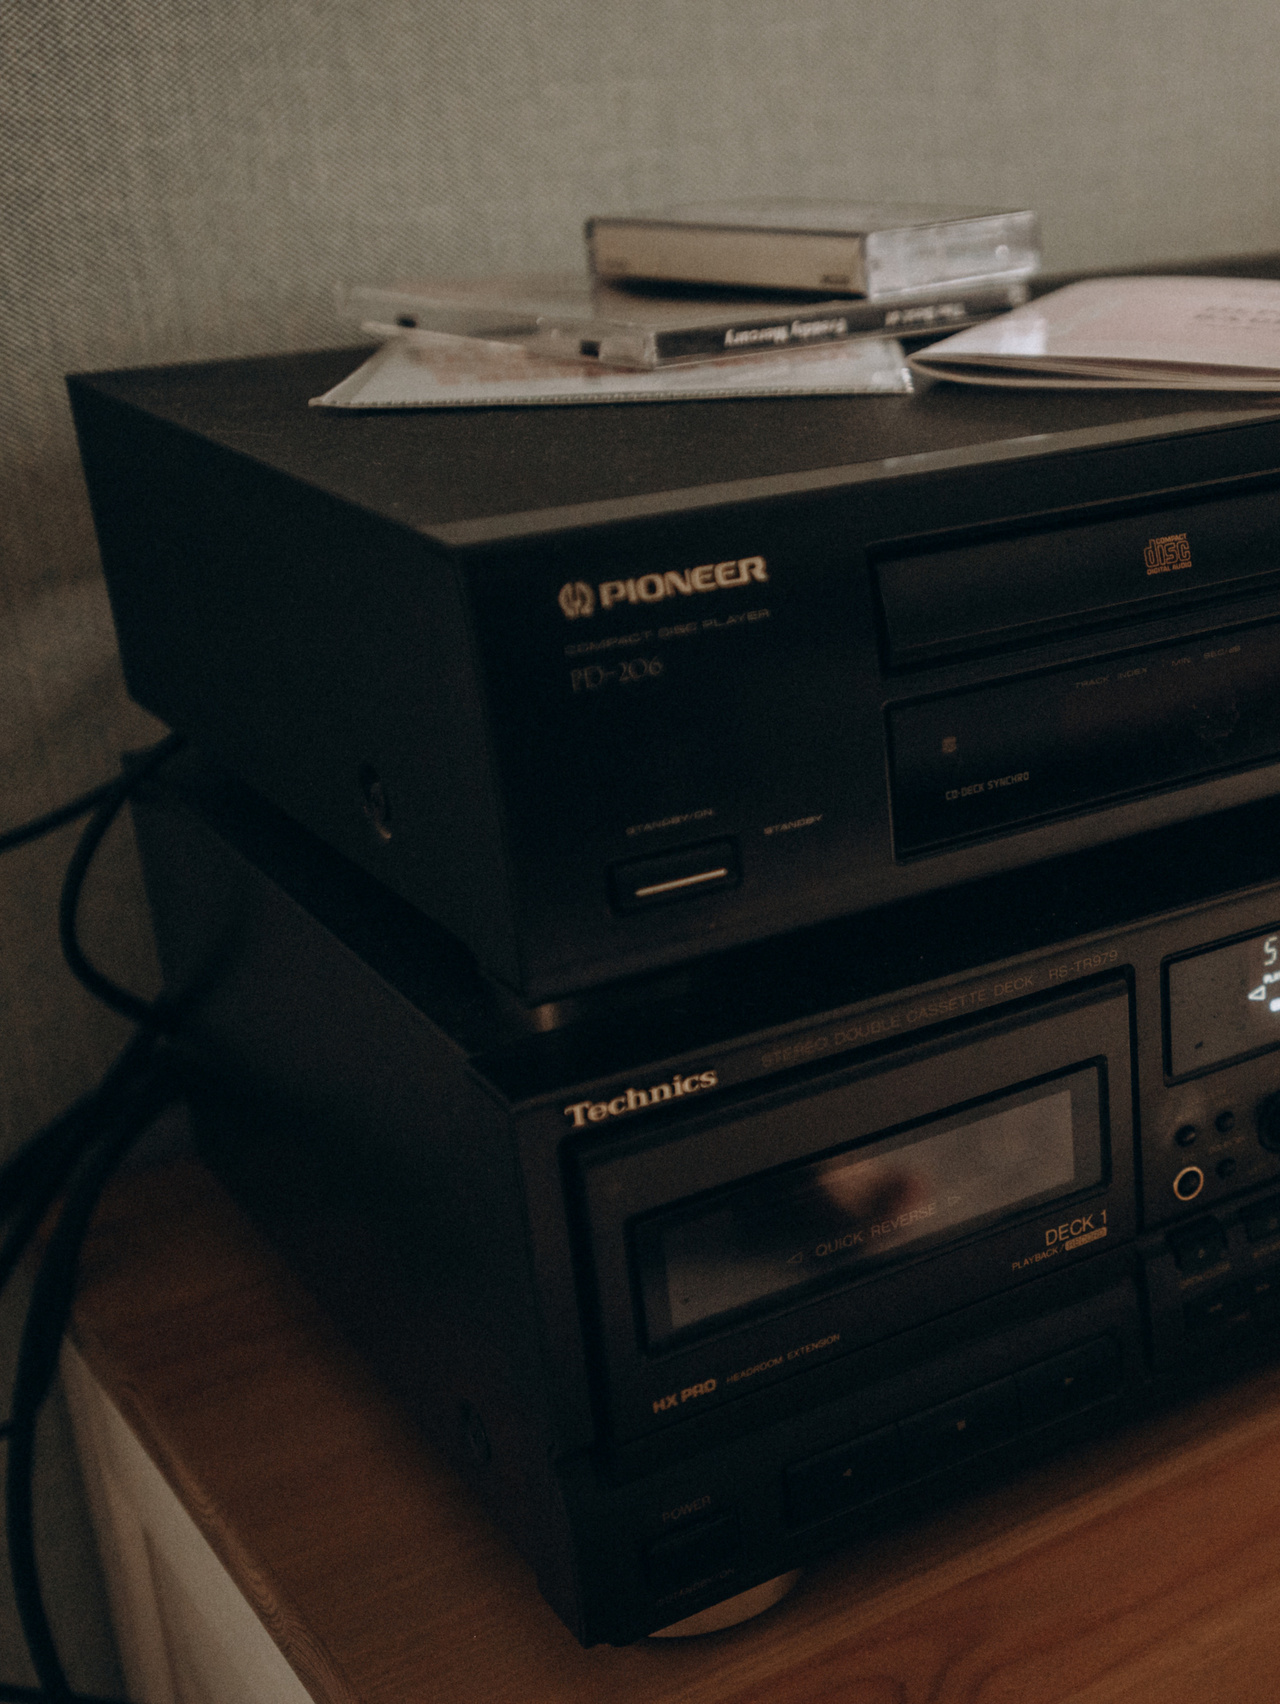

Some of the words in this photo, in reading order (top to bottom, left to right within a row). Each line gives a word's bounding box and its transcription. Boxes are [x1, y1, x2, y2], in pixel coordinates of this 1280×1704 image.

[599, 555, 769, 610] PIONEER
[564, 630, 652, 656] COMPACT
[658, 622, 698, 640] DISC
[702, 608, 771, 629] PLAYER
[570, 655, 664, 692] PD-206
[987, 771, 1030, 791] SYNCHRO
[761, 1036, 827, 1067] STEREO
[834, 1015, 901, 1045] DOUBLE
[906, 989, 986, 1024] CASSETTE
[993, 975, 1034, 997] DECK
[1049, 950, 1119, 981] RS-TR979
[564, 1068, 718, 1128] Technics
[815, 1231, 864, 1258] QUICK
[870, 1202, 937, 1239] REVERSE
[1045, 1213, 1094, 1247] DECK
[1100, 1209, 1107, 1224] 1
[652, 1393, 679, 1414] HX
[680, 1378, 717, 1403] PRO
[726, 1356, 784, 1384] HEADROOM
[787, 1333, 841, 1361] EXTENSION
[662, 1495, 712, 1523] POWER
